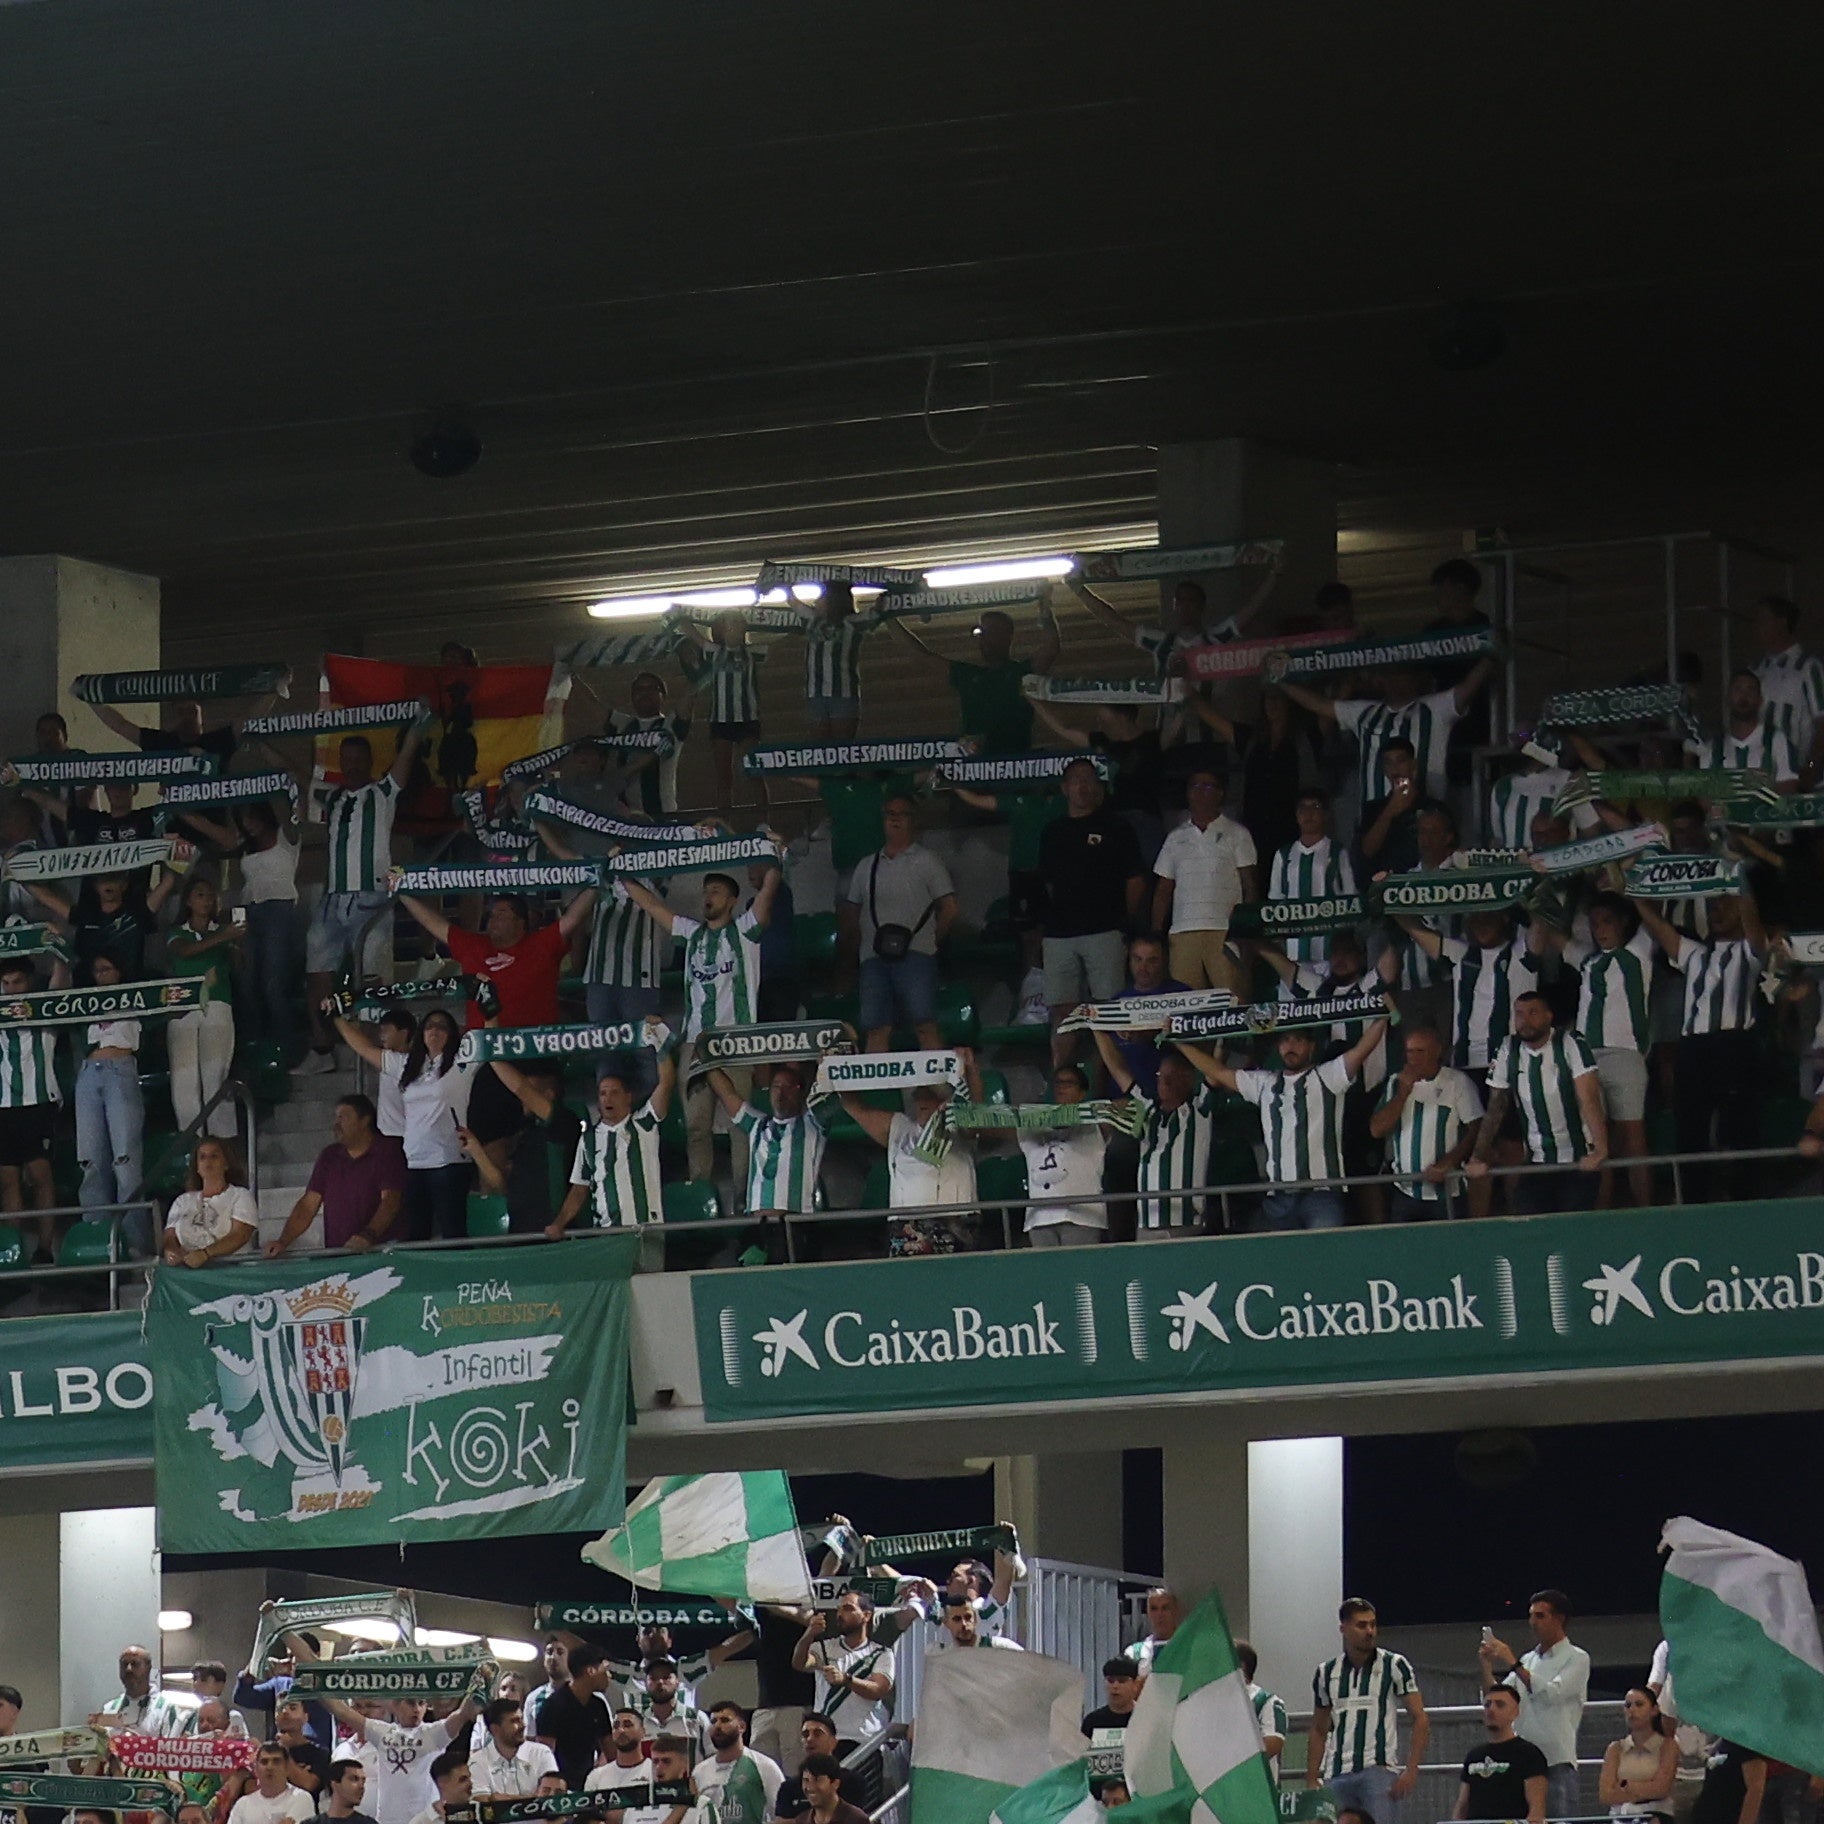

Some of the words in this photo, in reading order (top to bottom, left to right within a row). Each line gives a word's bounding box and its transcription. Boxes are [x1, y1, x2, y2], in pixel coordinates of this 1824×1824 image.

[40, 991, 146, 1018] CÓRDOBA
[1170, 1012, 1245, 1034] Brigadas
[1277, 992, 1384, 1020] Blanquiverdes
[533, 1024, 633, 1052] CÓRDOBA
[707, 1031, 812, 1056] CÓRDOBA
[828, 1061, 916, 1080] CÓRDOBA
[458, 1280, 512, 1303] PEÑA
[1234, 1279, 1484, 1340] CaixaBank
[823, 1306, 1066, 1369] CaixaBank
[442, 1350, 532, 1384] Infantil
[562, 1605, 689, 1625] CÓRDOBA
[157, 1738, 214, 1756] MUJER
[134, 1752, 233, 1770] CORDOBESA
